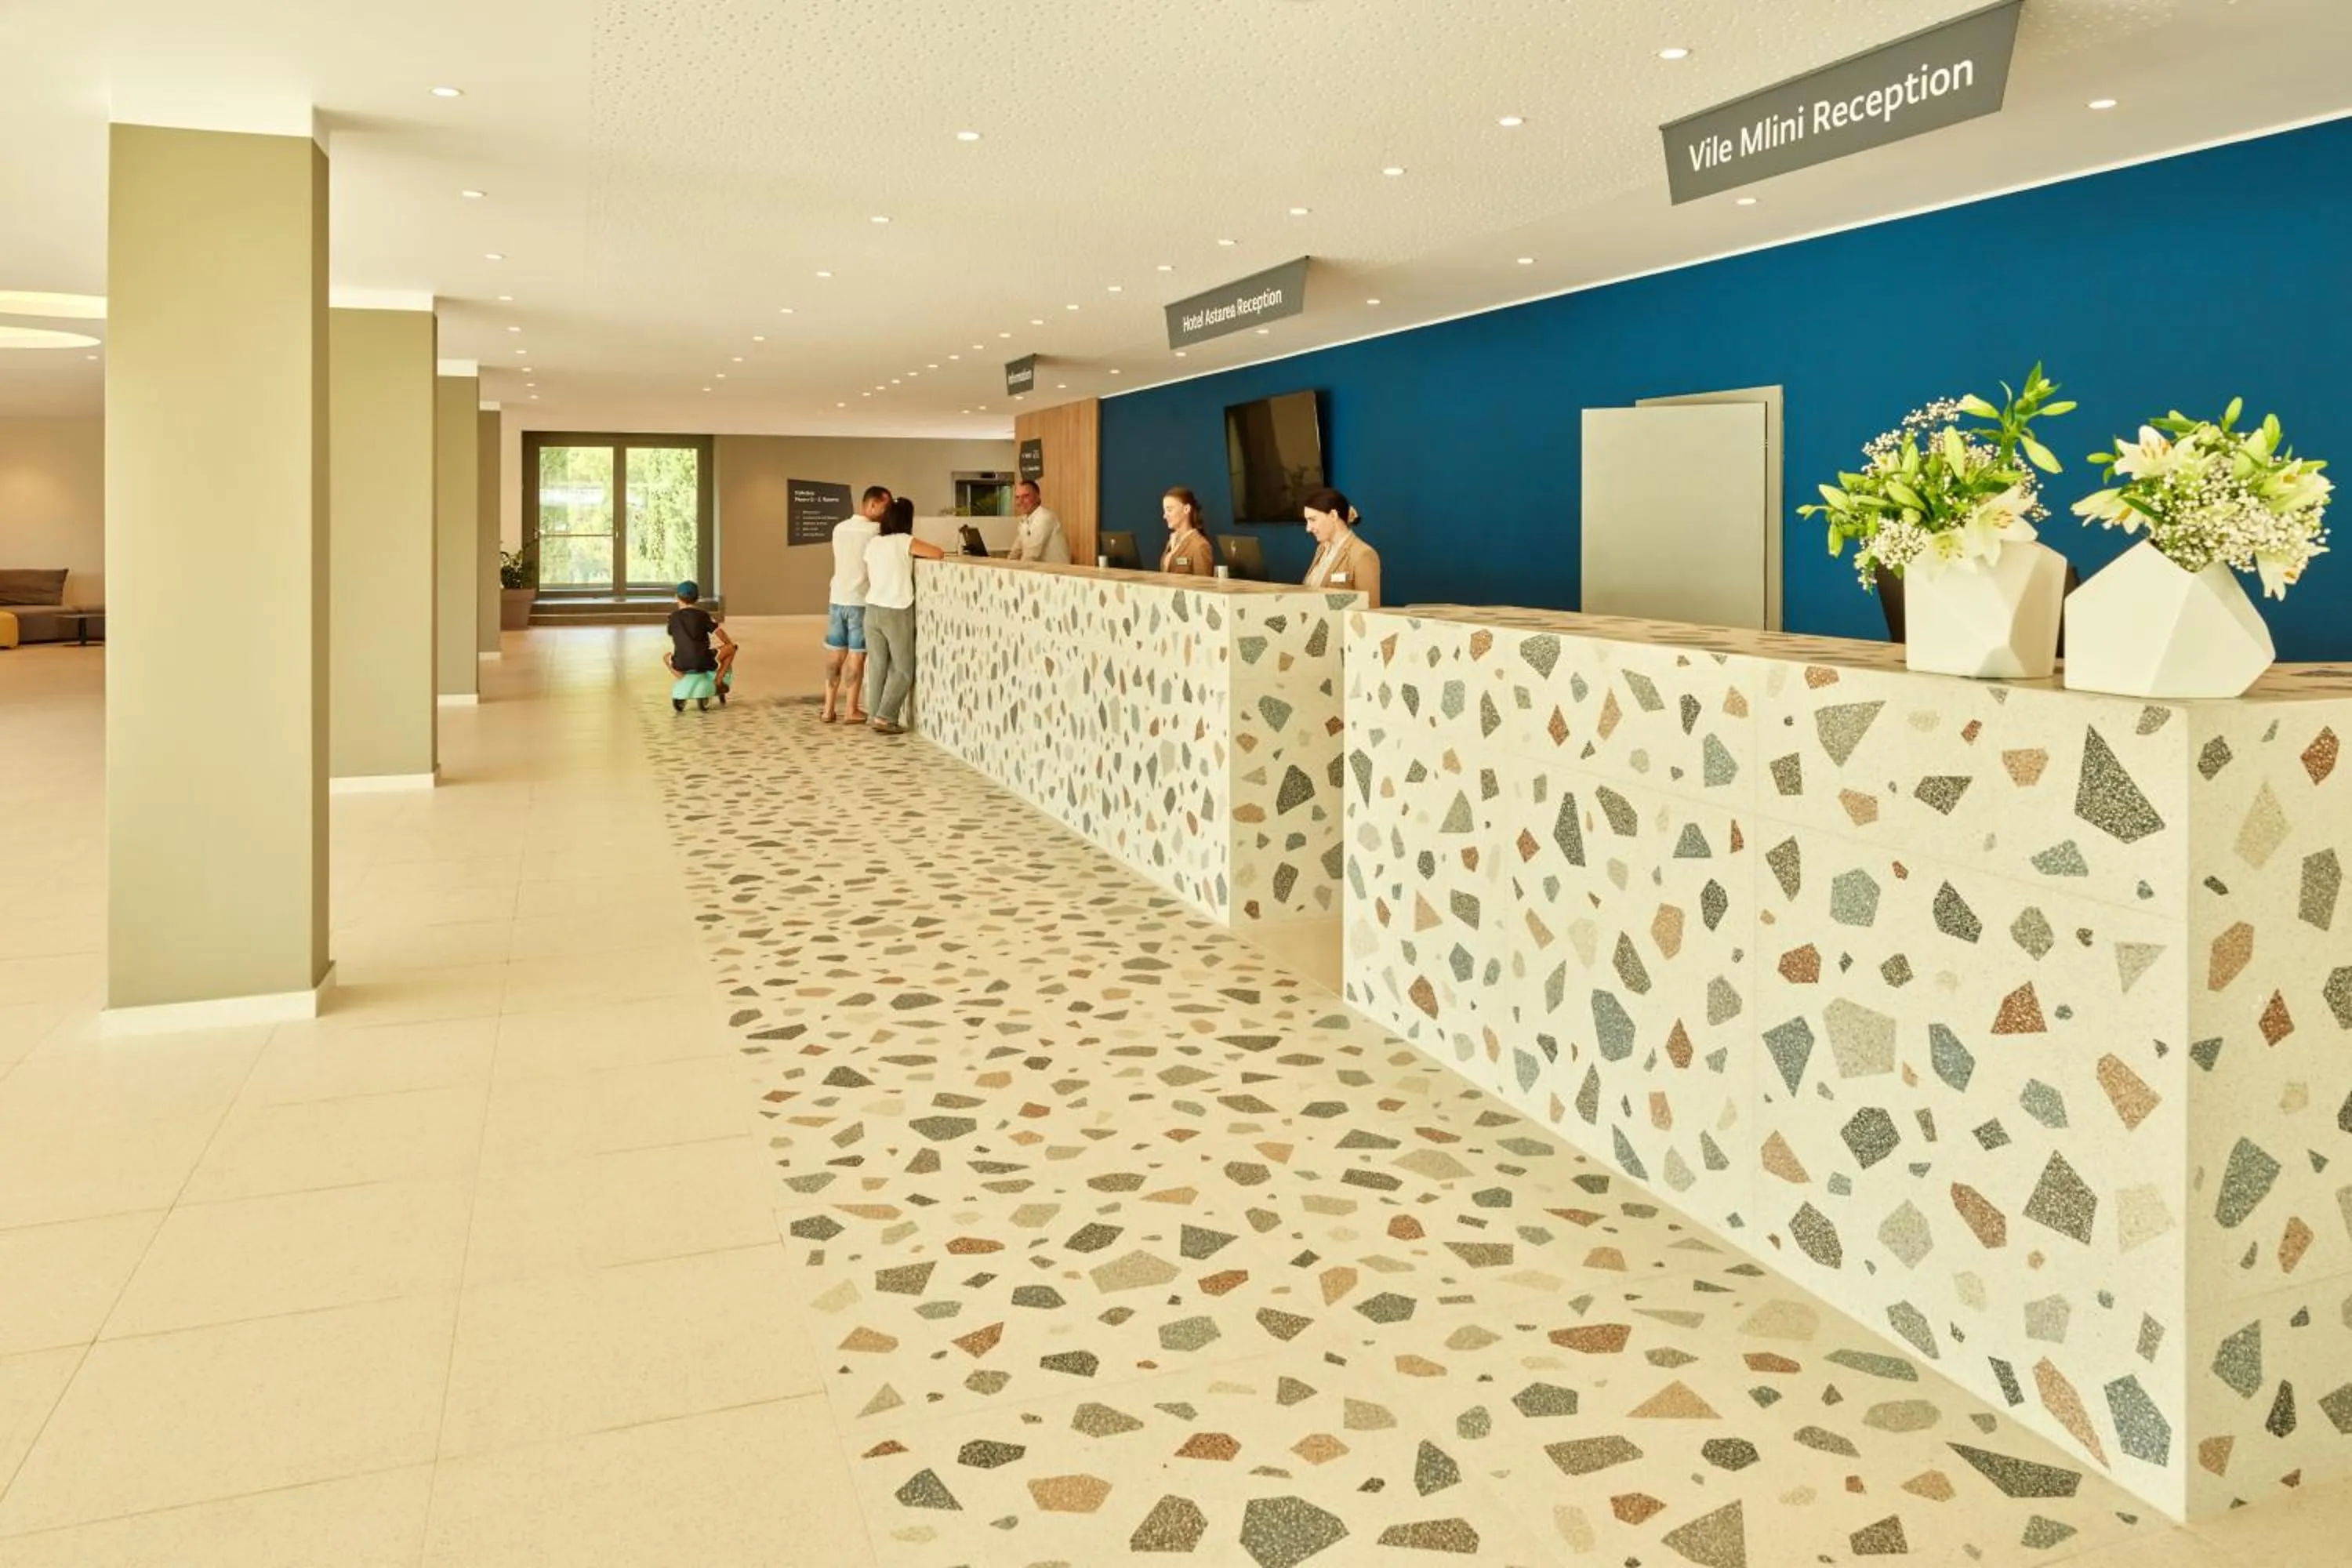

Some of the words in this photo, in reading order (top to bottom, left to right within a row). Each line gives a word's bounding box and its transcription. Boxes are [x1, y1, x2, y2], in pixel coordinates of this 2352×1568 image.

[1688, 135, 1733, 172] Vile
[1740, 106, 1804, 157] Mlini
[1813, 59, 1973, 134] Reception
[1182, 310, 1204, 332] Hotel
[1205, 304, 1236, 326] Astarea
[1236, 288, 1283, 315] Reception
